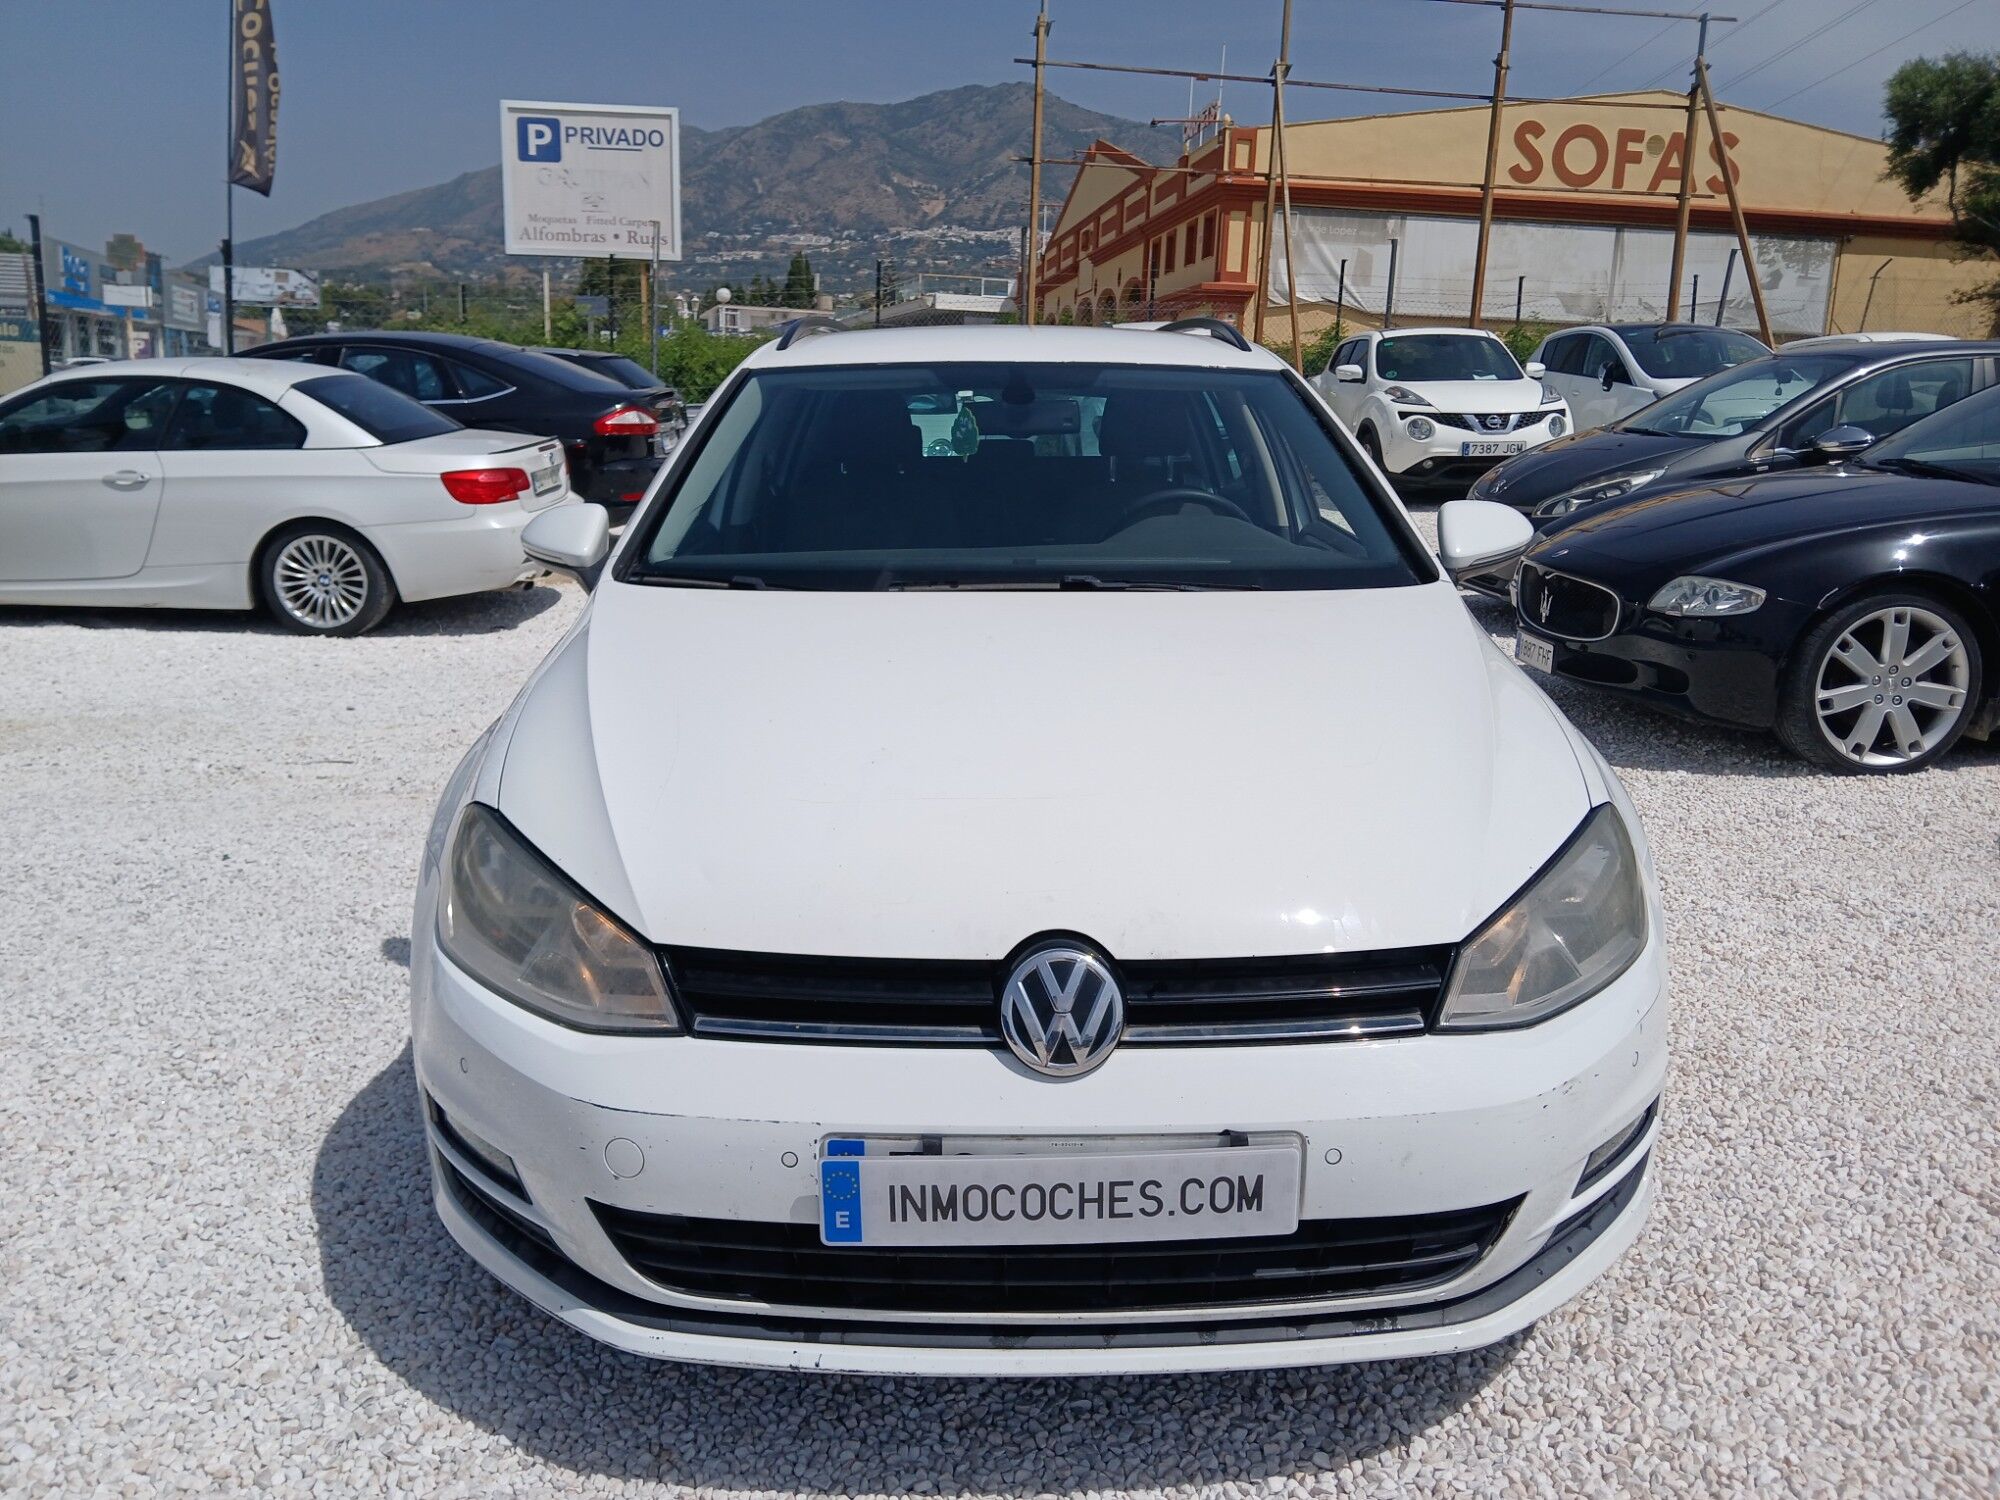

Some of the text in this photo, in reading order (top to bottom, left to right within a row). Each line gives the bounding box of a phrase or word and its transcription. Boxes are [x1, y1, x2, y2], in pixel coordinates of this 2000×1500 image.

[527, 123, 664, 156] P PRIVADO
[1507, 119, 1741, 195] SOFAS
[519, 226, 607, 242] Alfombras
[619, 216, 658, 229] Carpe
[1471, 444, 1499, 455] 7387
[836, 1174, 1264, 1228] E INMOCOCHES.COM
